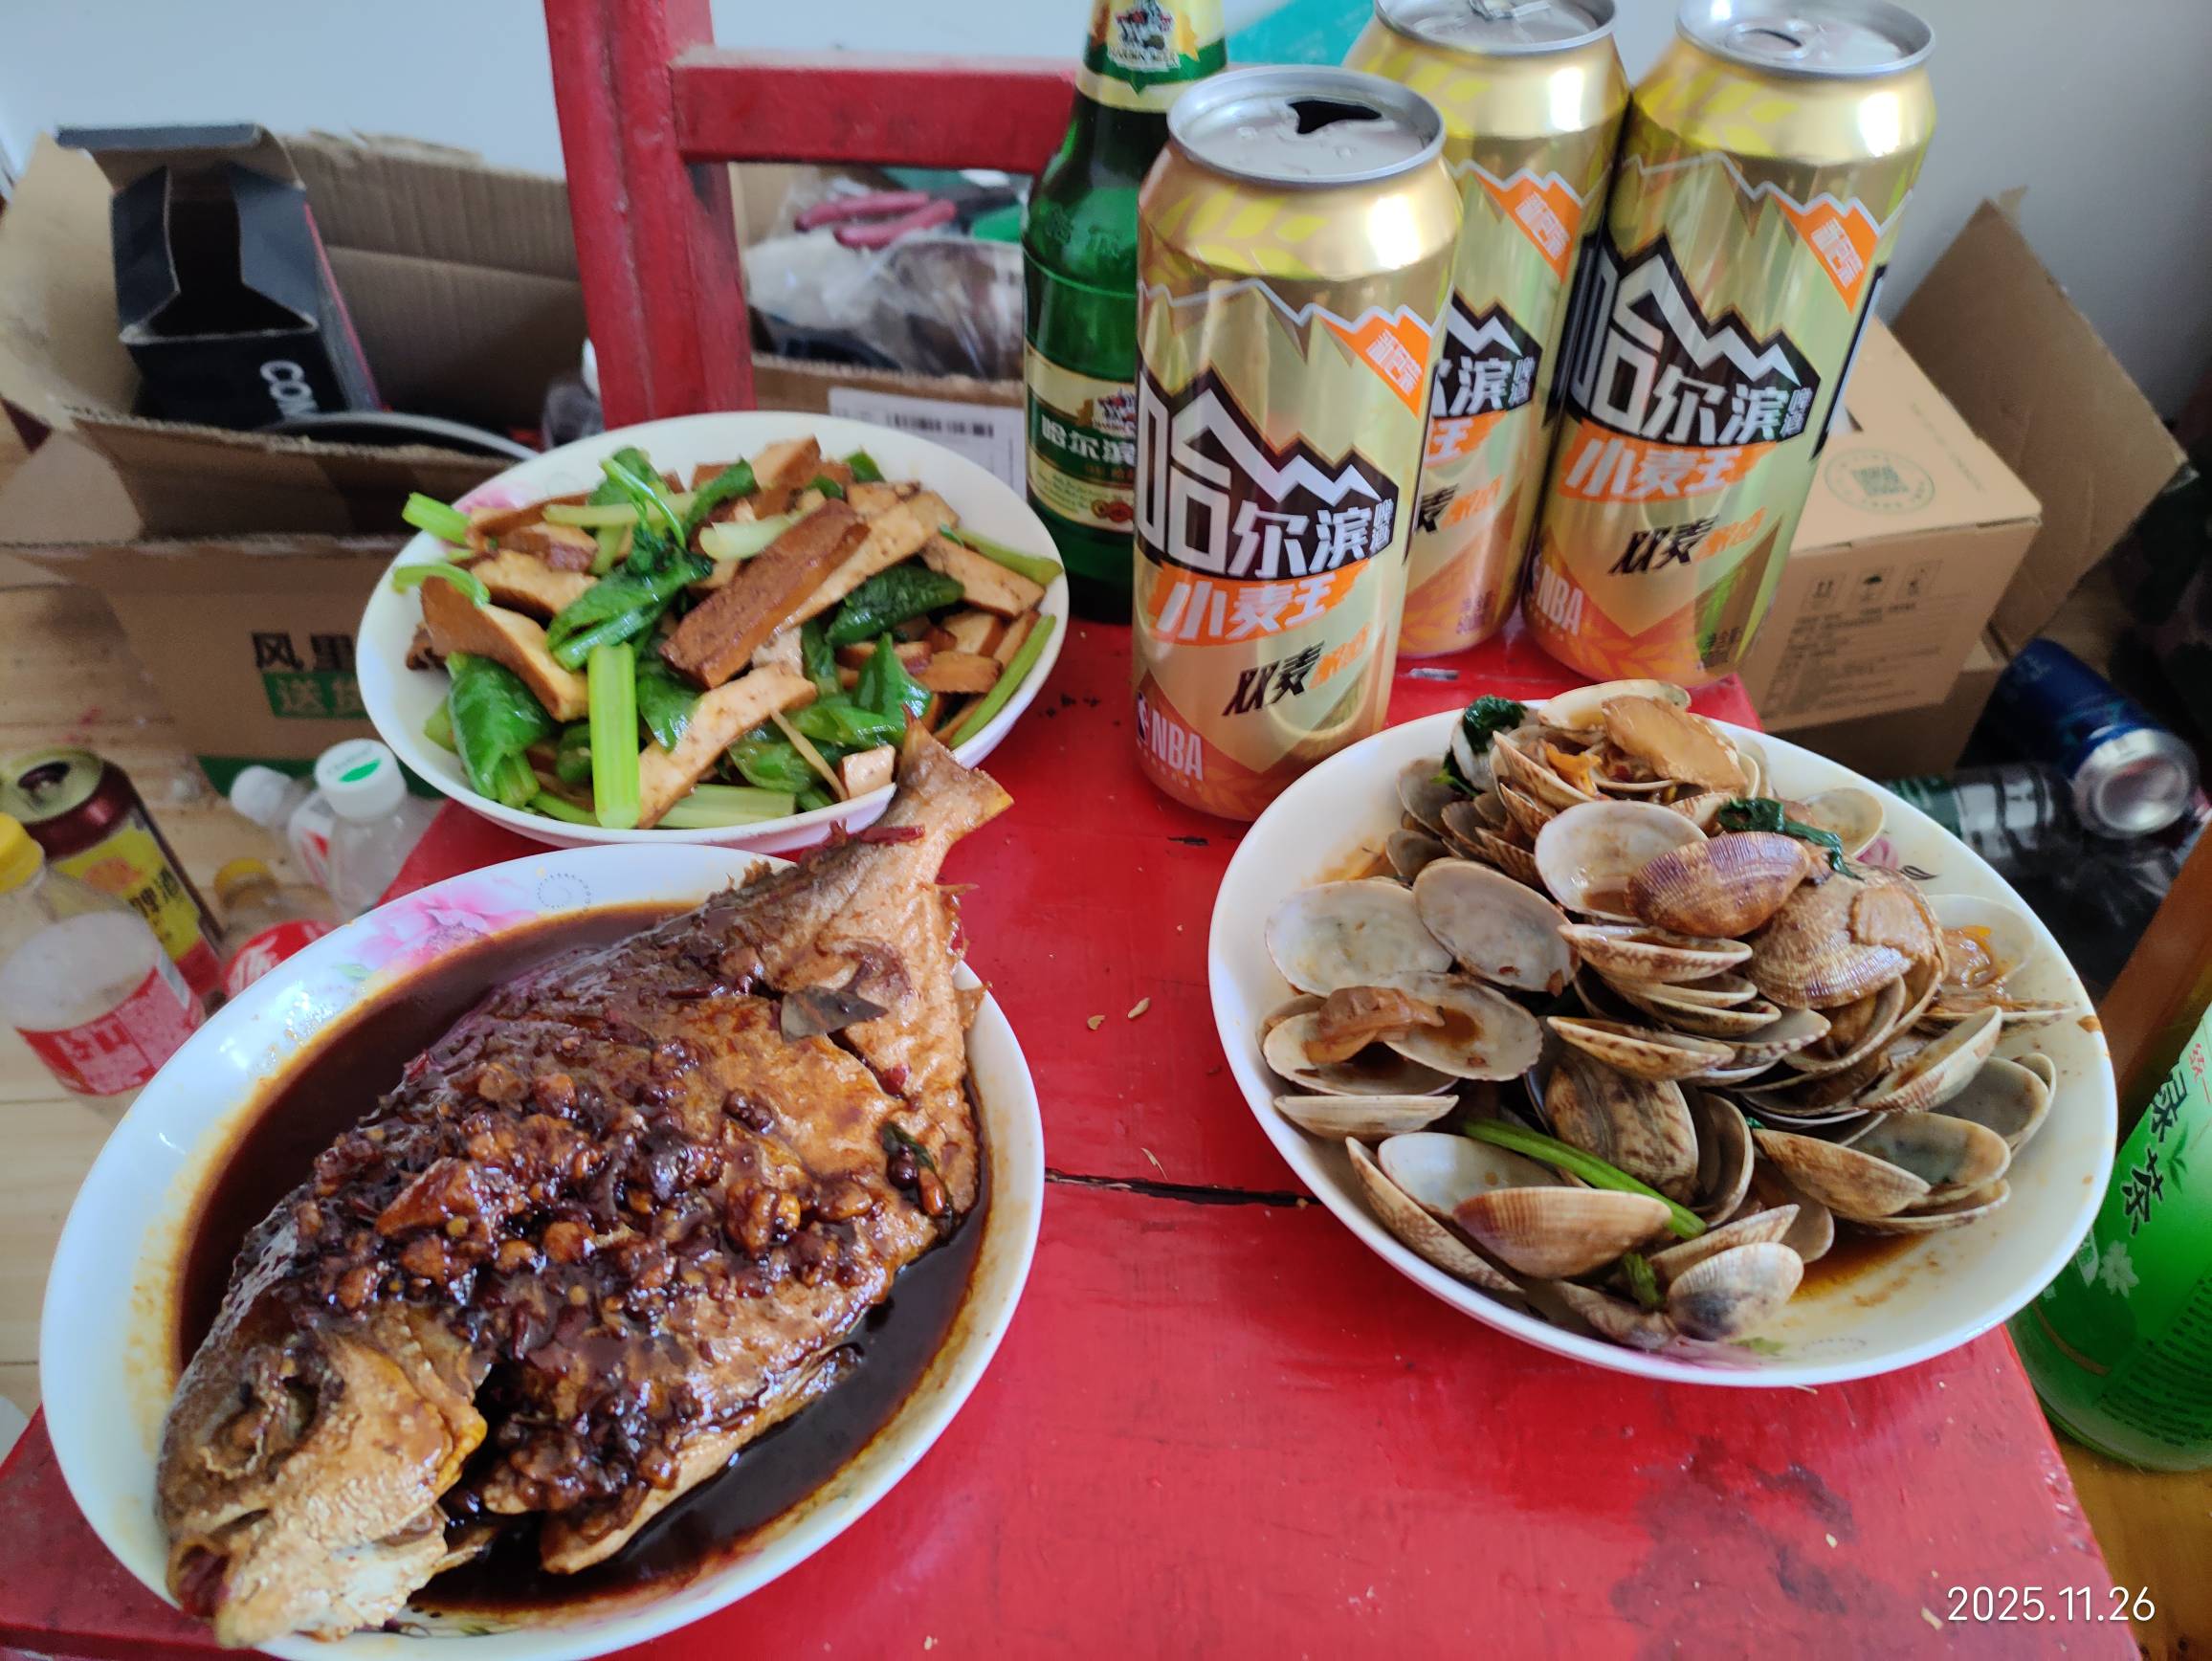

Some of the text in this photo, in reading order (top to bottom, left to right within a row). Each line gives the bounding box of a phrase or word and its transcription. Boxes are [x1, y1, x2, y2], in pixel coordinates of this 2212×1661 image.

[1571, 242, 1802, 444] 哈尔滨
[1137, 370, 1382, 578] 哈尔滨
[1565, 439, 1742, 497] 小麦王
[1156, 573, 1337, 640] 小麦王
[1536, 563, 1584, 636] NBA
[1151, 710, 1204, 782] NBA
